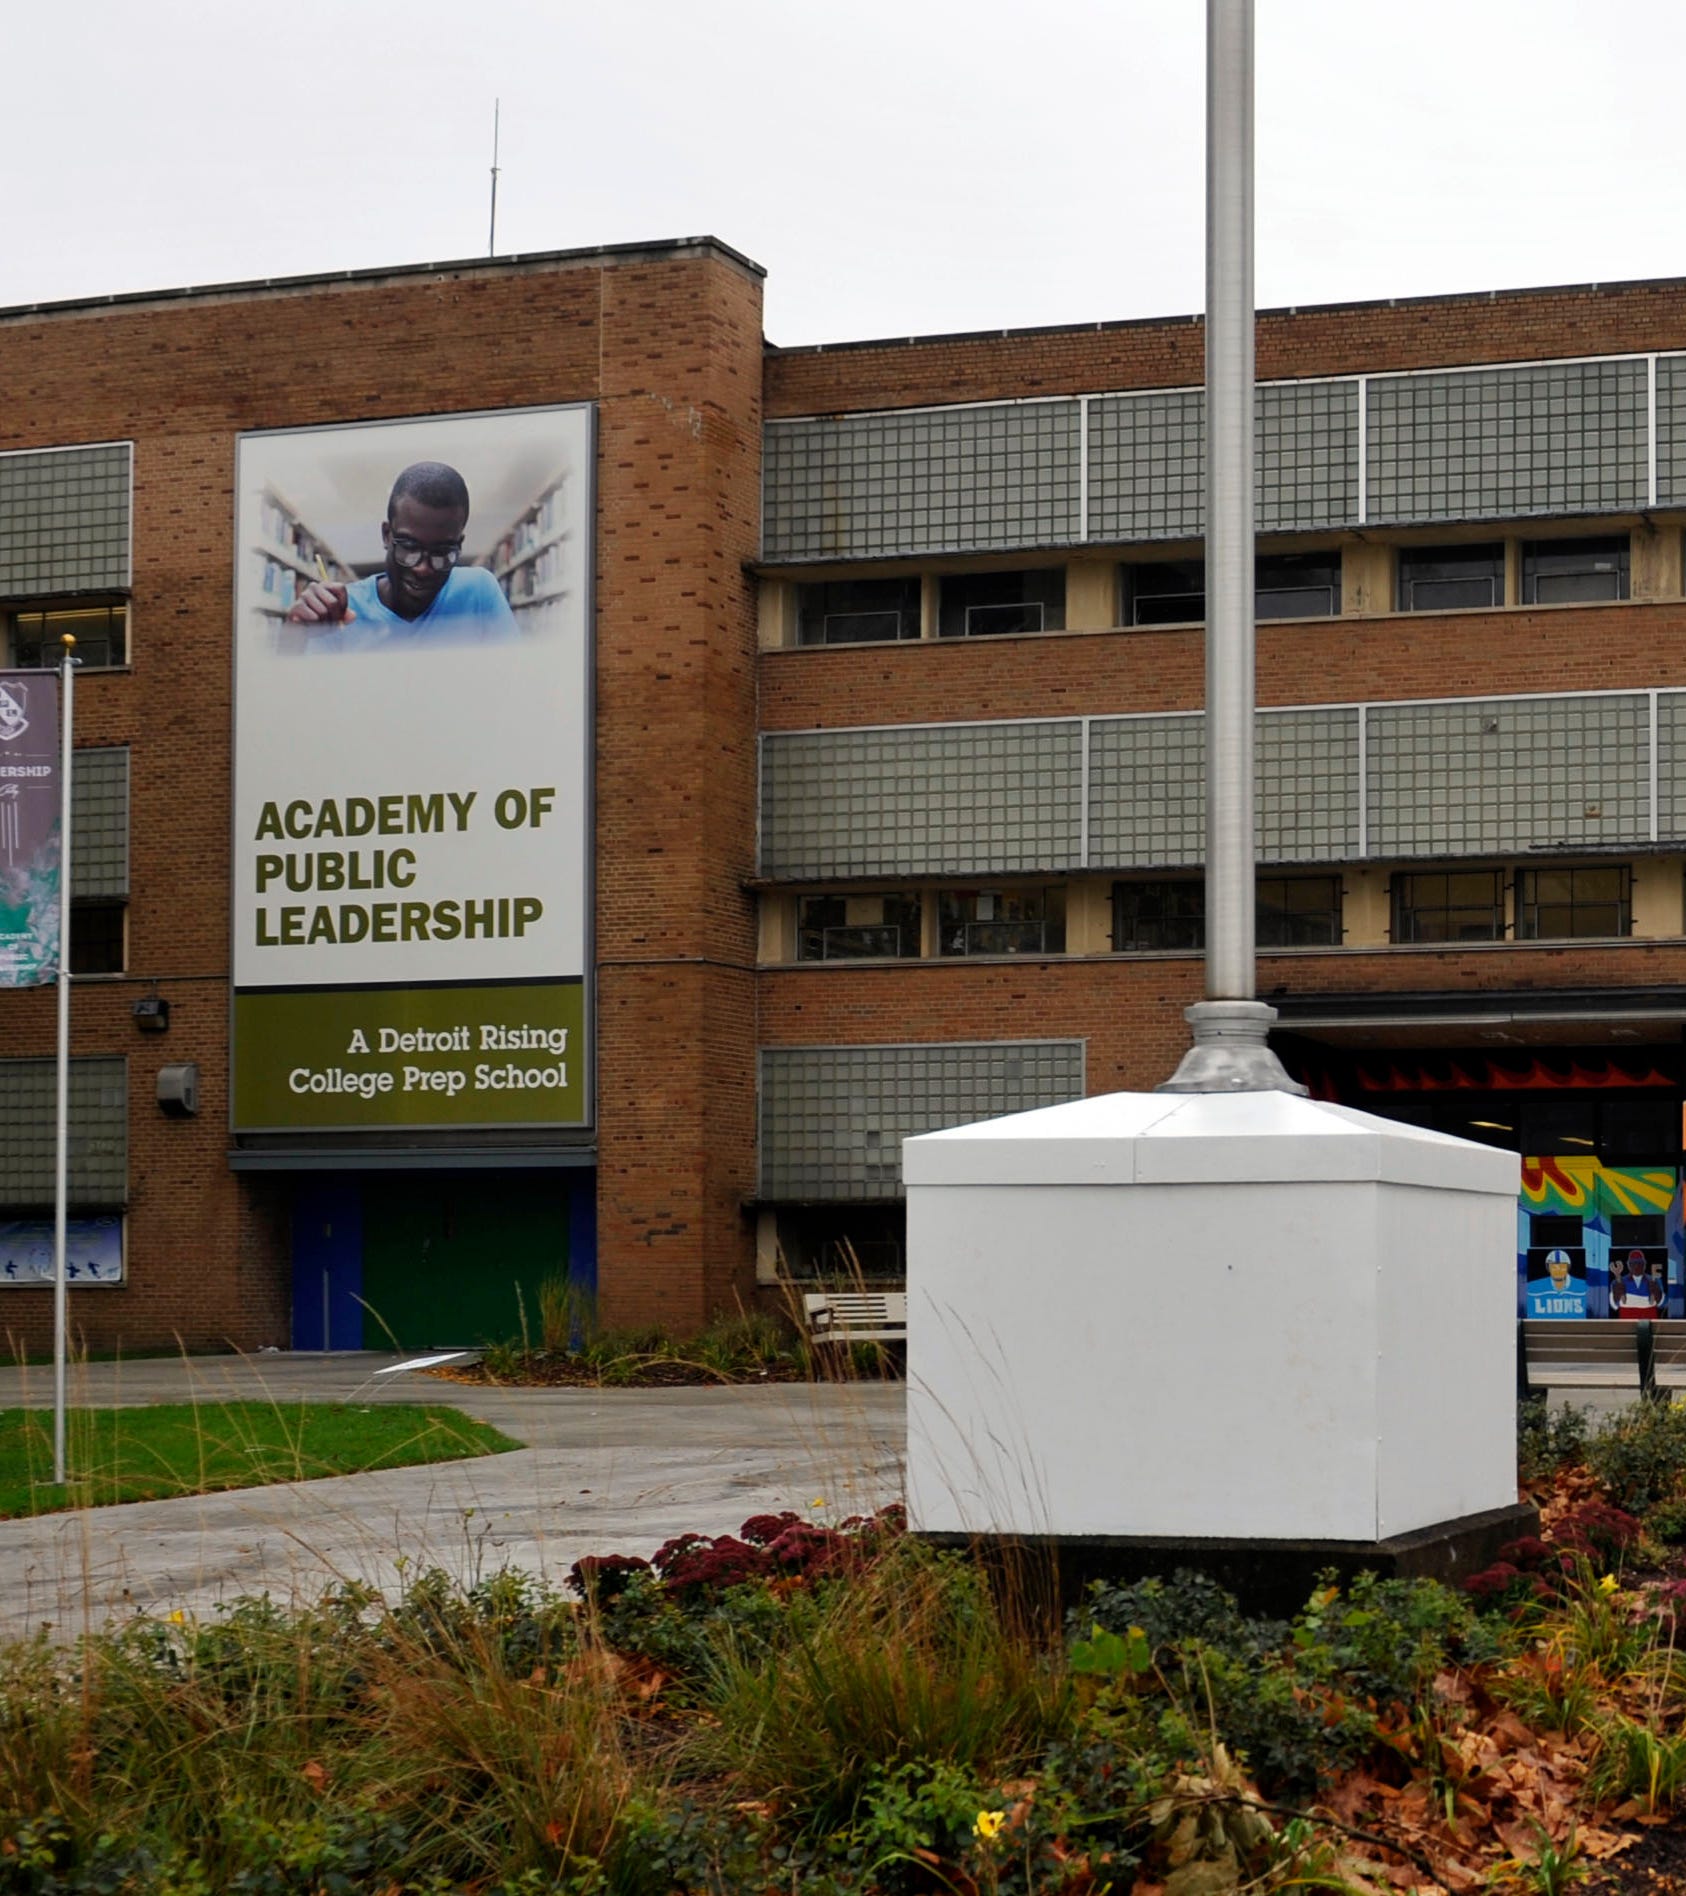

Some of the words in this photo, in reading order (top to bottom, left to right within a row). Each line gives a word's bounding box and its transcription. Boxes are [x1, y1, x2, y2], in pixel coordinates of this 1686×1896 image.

[254, 791, 478, 841] ACADEMY
[494, 787, 556, 830] OF
[255, 848, 417, 894] PUBLIC
[255, 897, 544, 947] LEADERSHIP
[346, 1028, 371, 1054] A
[378, 1025, 471, 1053] Detroit
[479, 1024, 568, 1055] Rising
[288, 1067, 394, 1099] College
[402, 1065, 467, 1097] Prep
[474, 1062, 568, 1091] School
[1534, 1298, 1585, 1314] LIONS
